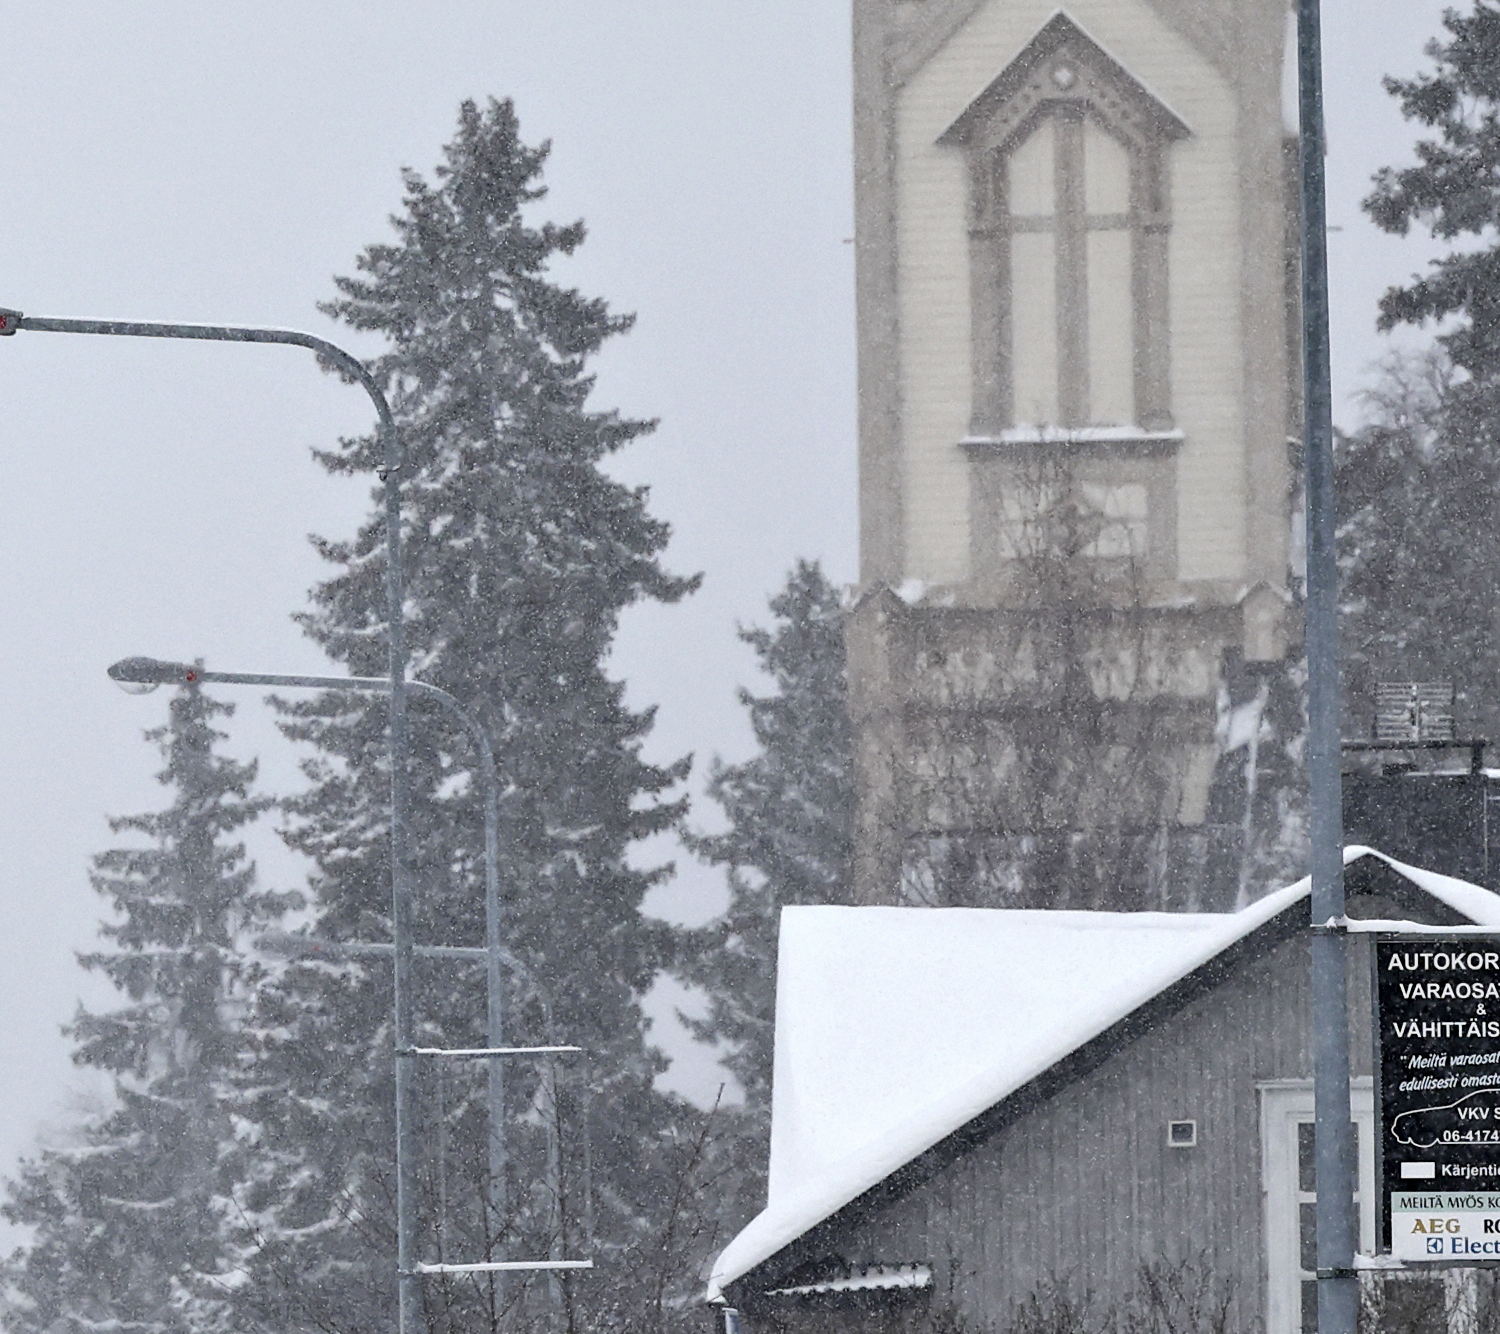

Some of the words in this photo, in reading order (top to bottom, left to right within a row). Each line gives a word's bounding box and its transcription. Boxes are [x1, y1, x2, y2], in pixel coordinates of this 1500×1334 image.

[1476, 1003, 1486, 1015] &
[1399, 1074, 1458, 1092] edullisesti
[1457, 1107, 1490, 1120] VKV
[1400, 1195, 1444, 1209] MEILTÄ
[1447, 1194, 1484, 1209] MYÖS
[1411, 1219, 1461, 1234] AEG
